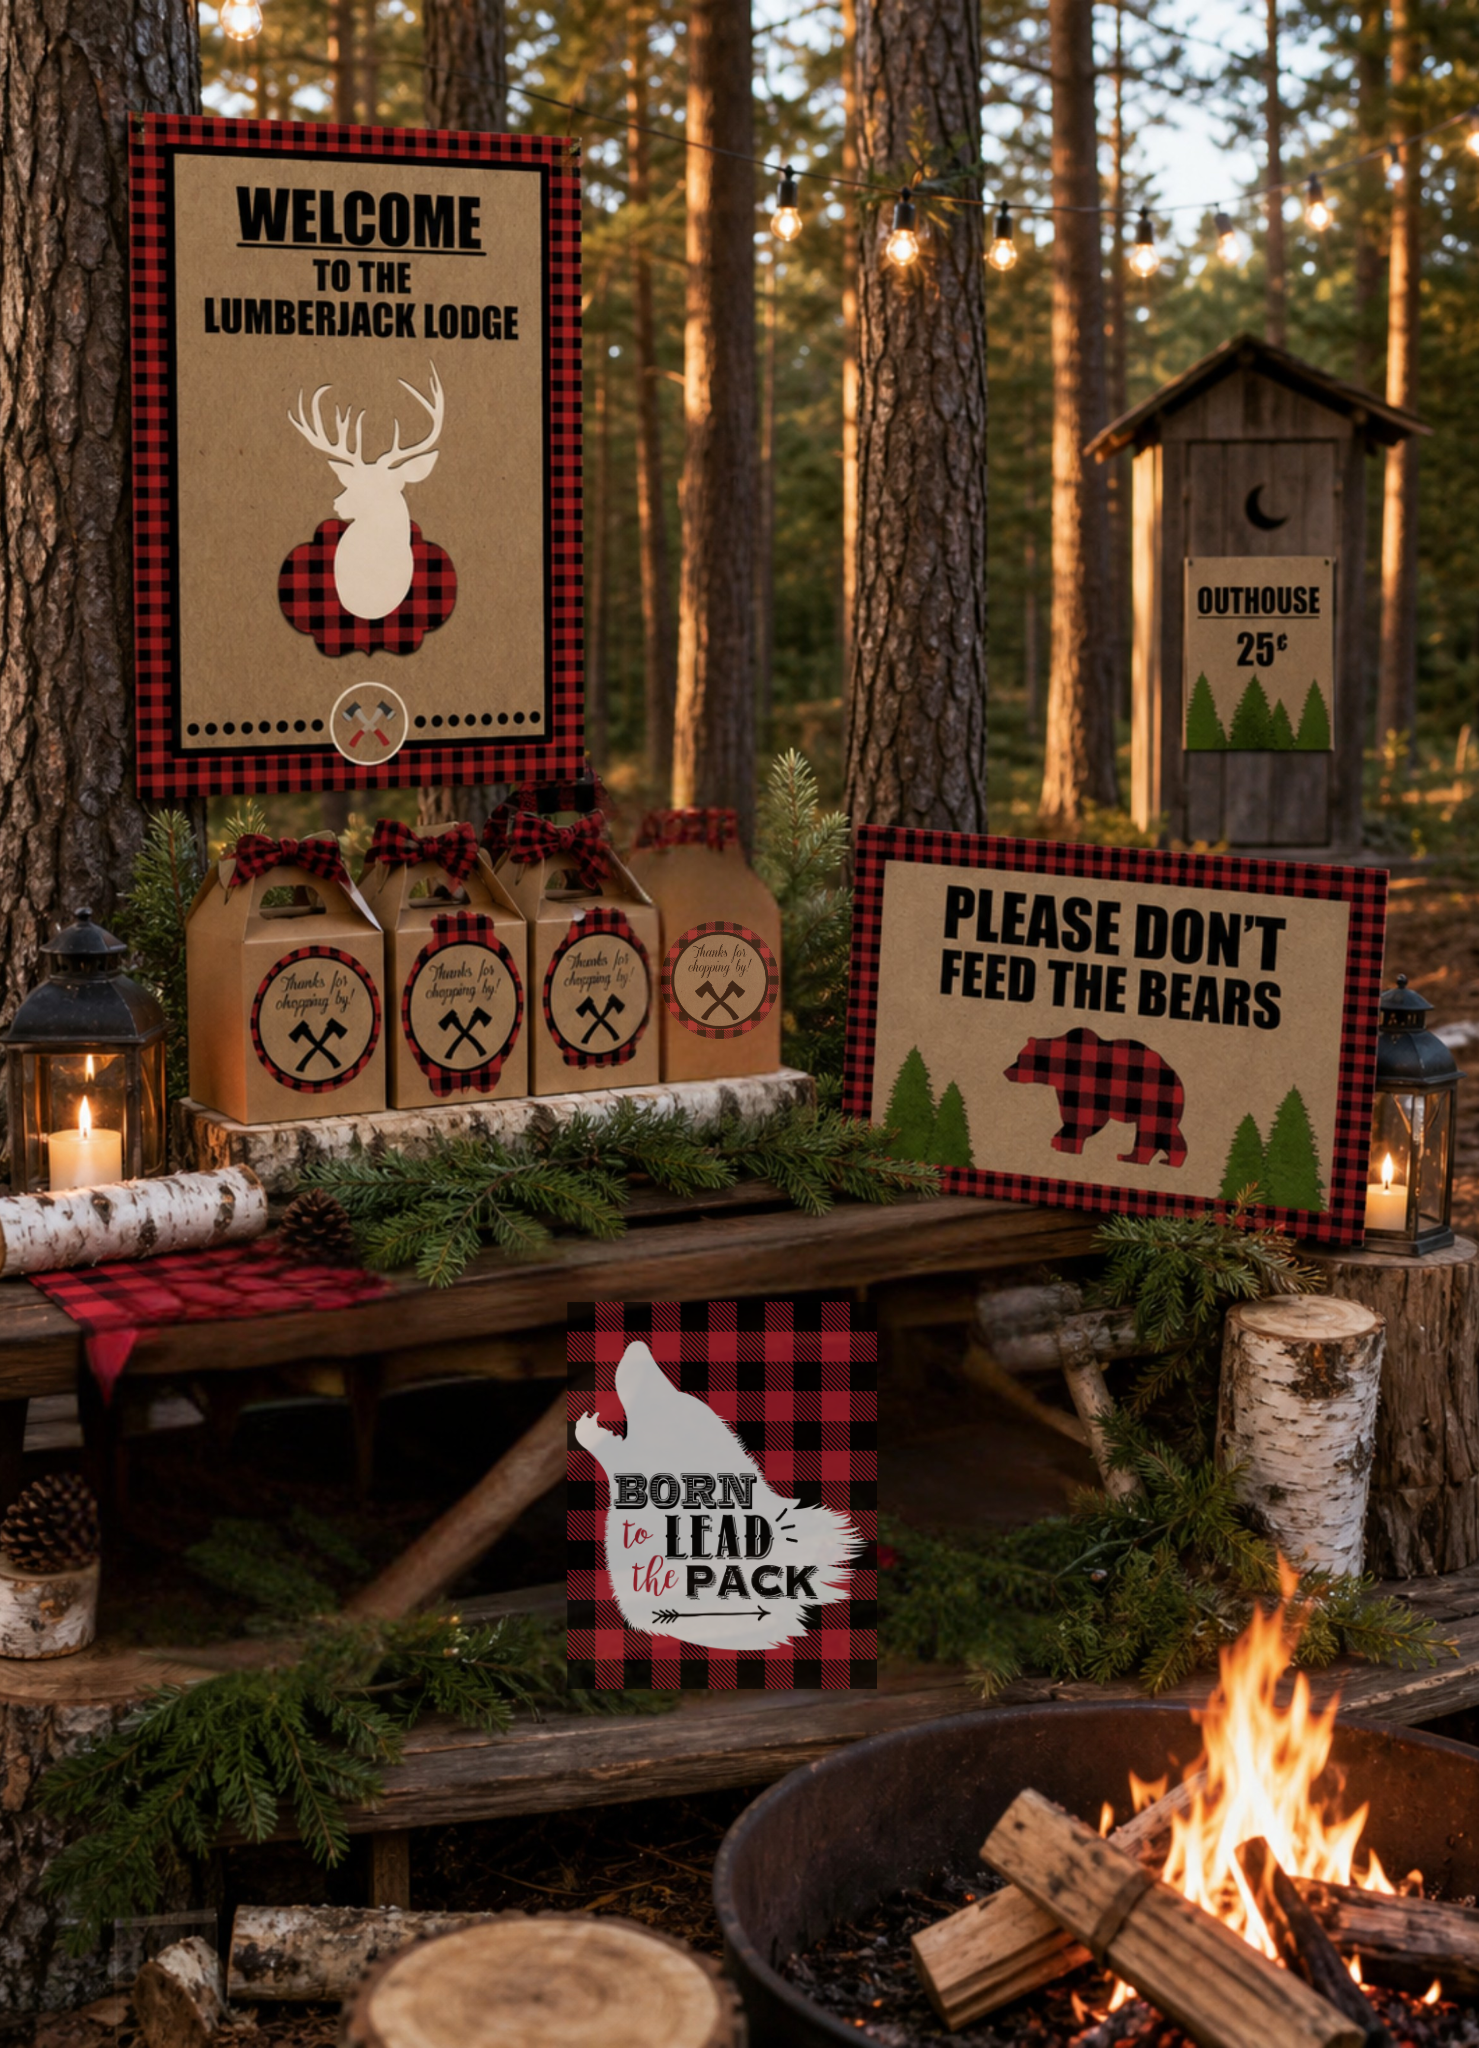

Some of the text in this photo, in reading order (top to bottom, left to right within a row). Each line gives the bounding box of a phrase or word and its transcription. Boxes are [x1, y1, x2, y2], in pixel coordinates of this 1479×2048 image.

[236, 186, 482, 250] WELCOME
[312, 258, 411, 295] TO THE
[203, 297, 519, 341] LUMBERJACK LODGE
[1197, 586, 1321, 615] OUTHOUSE
[1236, 631, 1288, 667] 25¢
[943, 885, 1287, 971] PLEASE DON'T
[688, 959, 752, 978] chopping by!
[692, 944, 748, 964] Thanks for
[940, 948, 1282, 1030] FEED THE BEARS
[613, 1472, 758, 1510] BORN
[622, 1514, 775, 1561] to LEAD
[631, 1554, 820, 1600] the PACK
